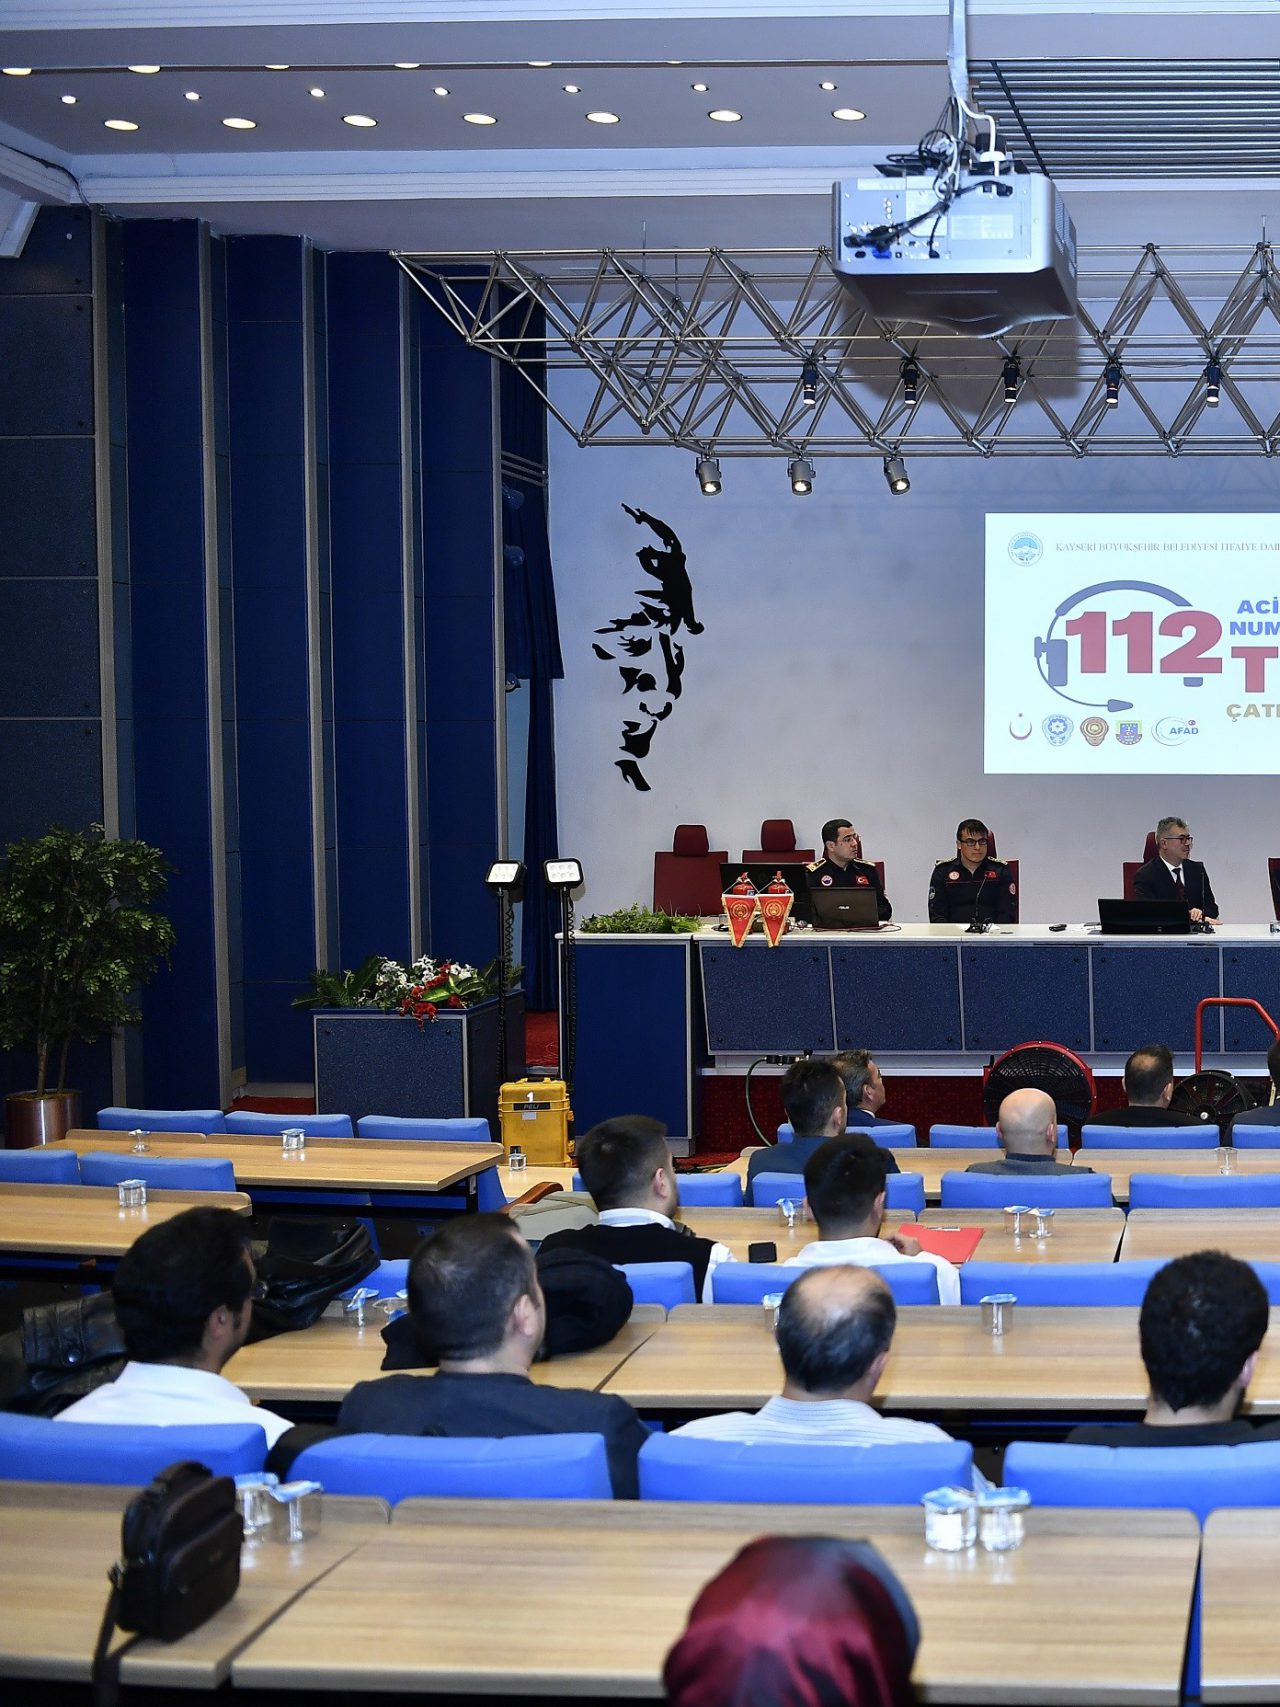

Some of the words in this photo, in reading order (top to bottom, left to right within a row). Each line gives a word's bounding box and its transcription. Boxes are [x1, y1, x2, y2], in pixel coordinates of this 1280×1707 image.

[1065, 610, 1222, 673] 112
[1169, 727, 1199, 735] AFAD
[527, 1091, 534, 1103] 1
